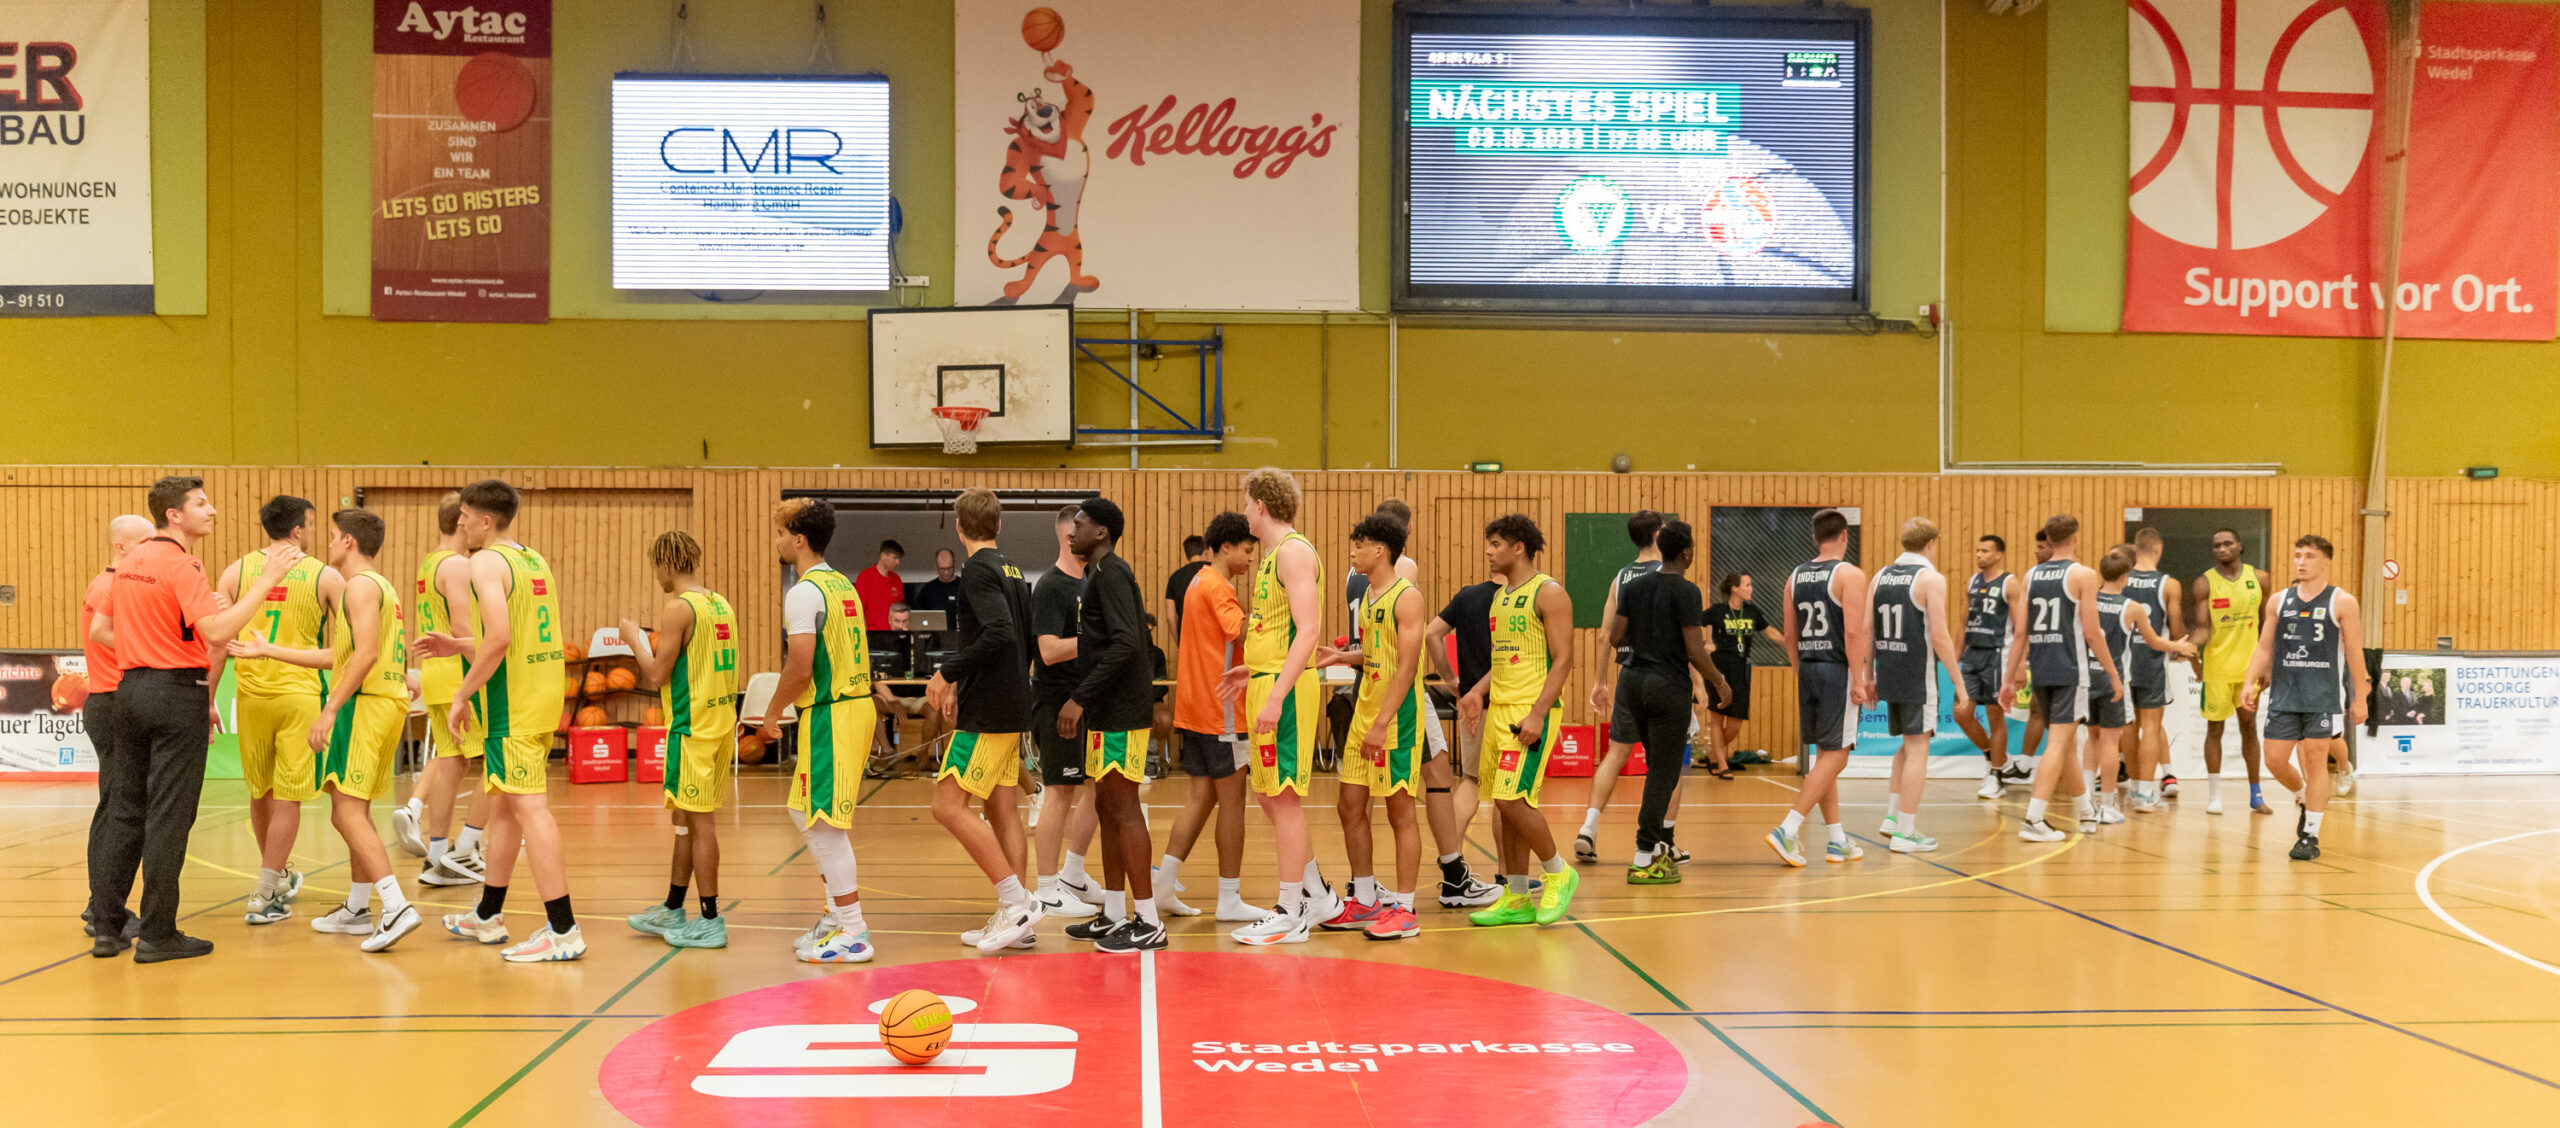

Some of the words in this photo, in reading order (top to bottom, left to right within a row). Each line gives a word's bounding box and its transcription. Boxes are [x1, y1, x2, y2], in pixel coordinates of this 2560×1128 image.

[397, 1, 527, 40] Aytac
[464, 34, 525, 43] Restaurant
[2427, 45, 2537, 63] Stadtsparkasse
[2427, 65, 2473, 80] Wedel
[1429, 85, 1616, 121] NÄCHSTES
[1627, 91, 1730, 122] SPIEL
[1, 114, 86, 146] BAU
[428, 120, 496, 132] ZUSAMMEN
[448, 136, 477, 148] SIND
[1106, 94, 1338, 179] Kellogg's
[1669, 131, 1719, 150] UHR
[450, 152, 473, 163] WIR
[660, 128, 844, 175] CMR
[434, 168, 456, 178] EIN
[458, 168, 490, 179] TEAM
[660, 182, 719, 194] Container
[805, 183, 843, 196] Repair
[382, 198, 427, 219] LETS
[432, 194, 458, 214] GO
[463, 186, 540, 211] RISTERS
[762, 200, 800, 211] GmbH
[426, 218, 471, 240] LETS
[476, 215, 502, 235] GO
[2184, 267, 2358, 317] Support
[2452, 273, 2534, 313] Ort.
[1983, 597, 1997, 615] 12
[2032, 597, 2061, 631] 21
[266, 610, 281, 643] 7
[537, 605, 551, 643] 2
[1508, 615, 1527, 632] 99
[1798, 600, 1829, 638] 23
[1878, 603, 1903, 639] 11
[1375, 630, 1381, 648] 1
[2312, 623, 2325, 641] 3
[2456, 666, 2560, 679] BESTATTUNGEN
[2456, 681, 2531, 694] VORSORGE
[2456, 696, 2560, 709] TRAUERKULTUR
[1191, 1040, 1635, 1056] Stadtsparkasse
[1191, 1058, 1379, 1072] Wedel
